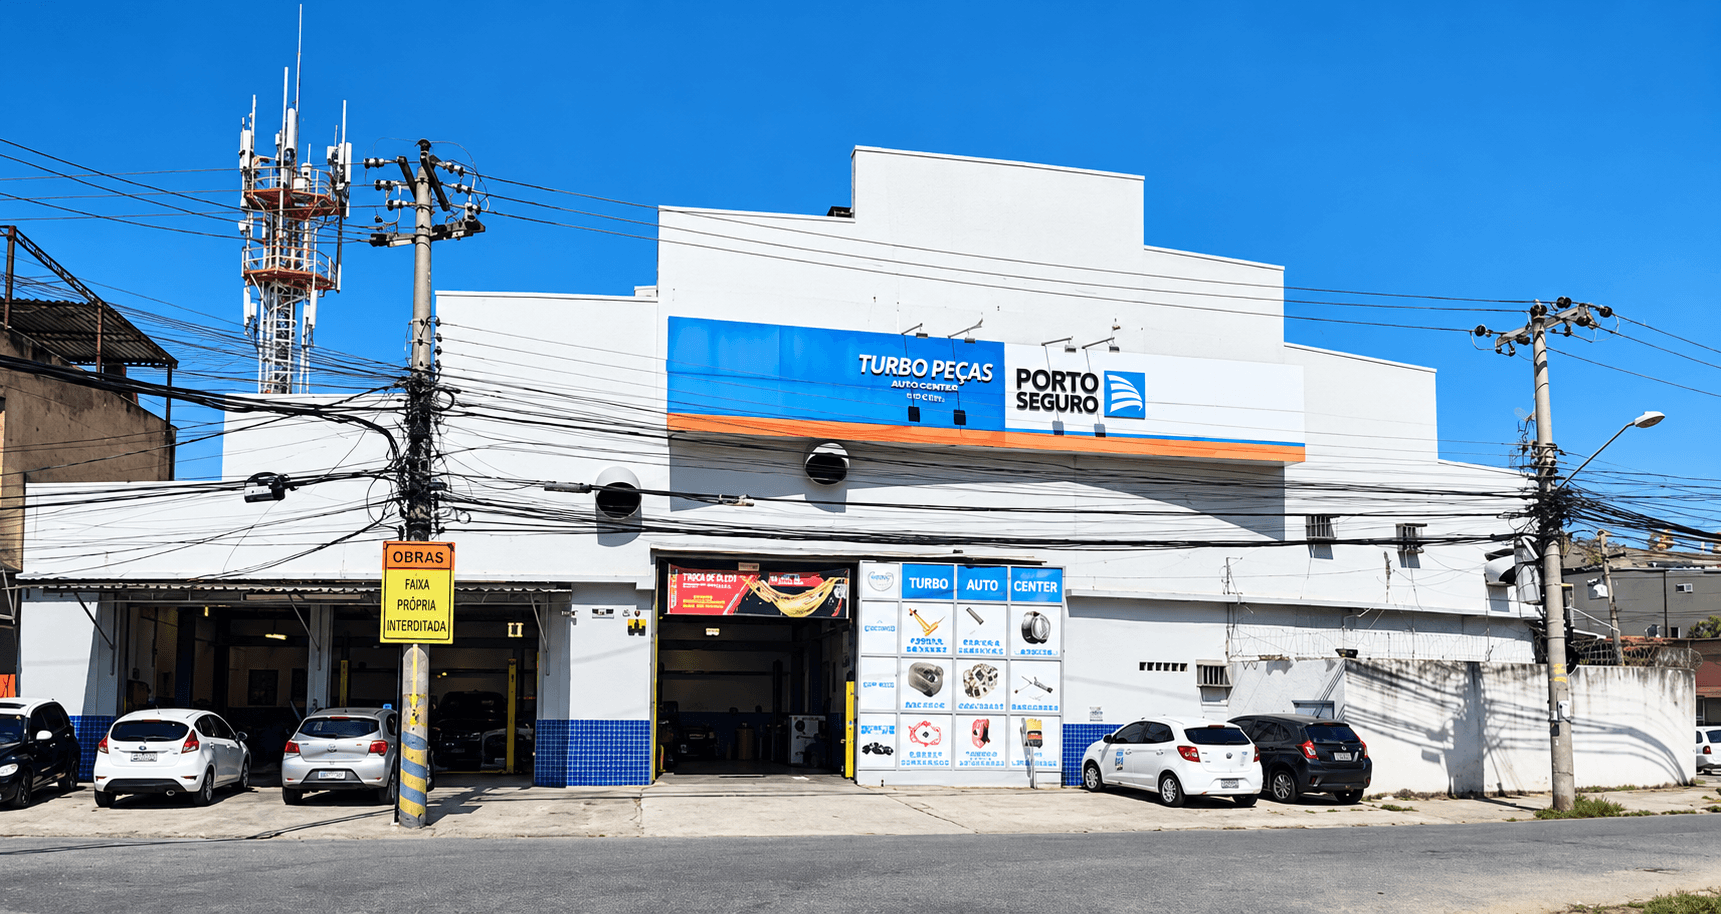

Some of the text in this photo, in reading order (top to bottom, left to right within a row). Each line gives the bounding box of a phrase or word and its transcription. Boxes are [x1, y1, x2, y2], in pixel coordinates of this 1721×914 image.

[859, 354, 994, 385] TURBO PEÇAS
[891, 380, 919, 389] AUTO
[1016, 368, 1099, 394] PORTO
[1016, 392, 1099, 414] SEGURO
[393, 551, 444, 563] OBRAS
[405, 578, 430, 590] FAIXA
[908, 577, 1058, 593] TURBO AUTO CENTER
[397, 596, 436, 611] PRÓPRIA
[387, 619, 447, 632] INTERDITADA
